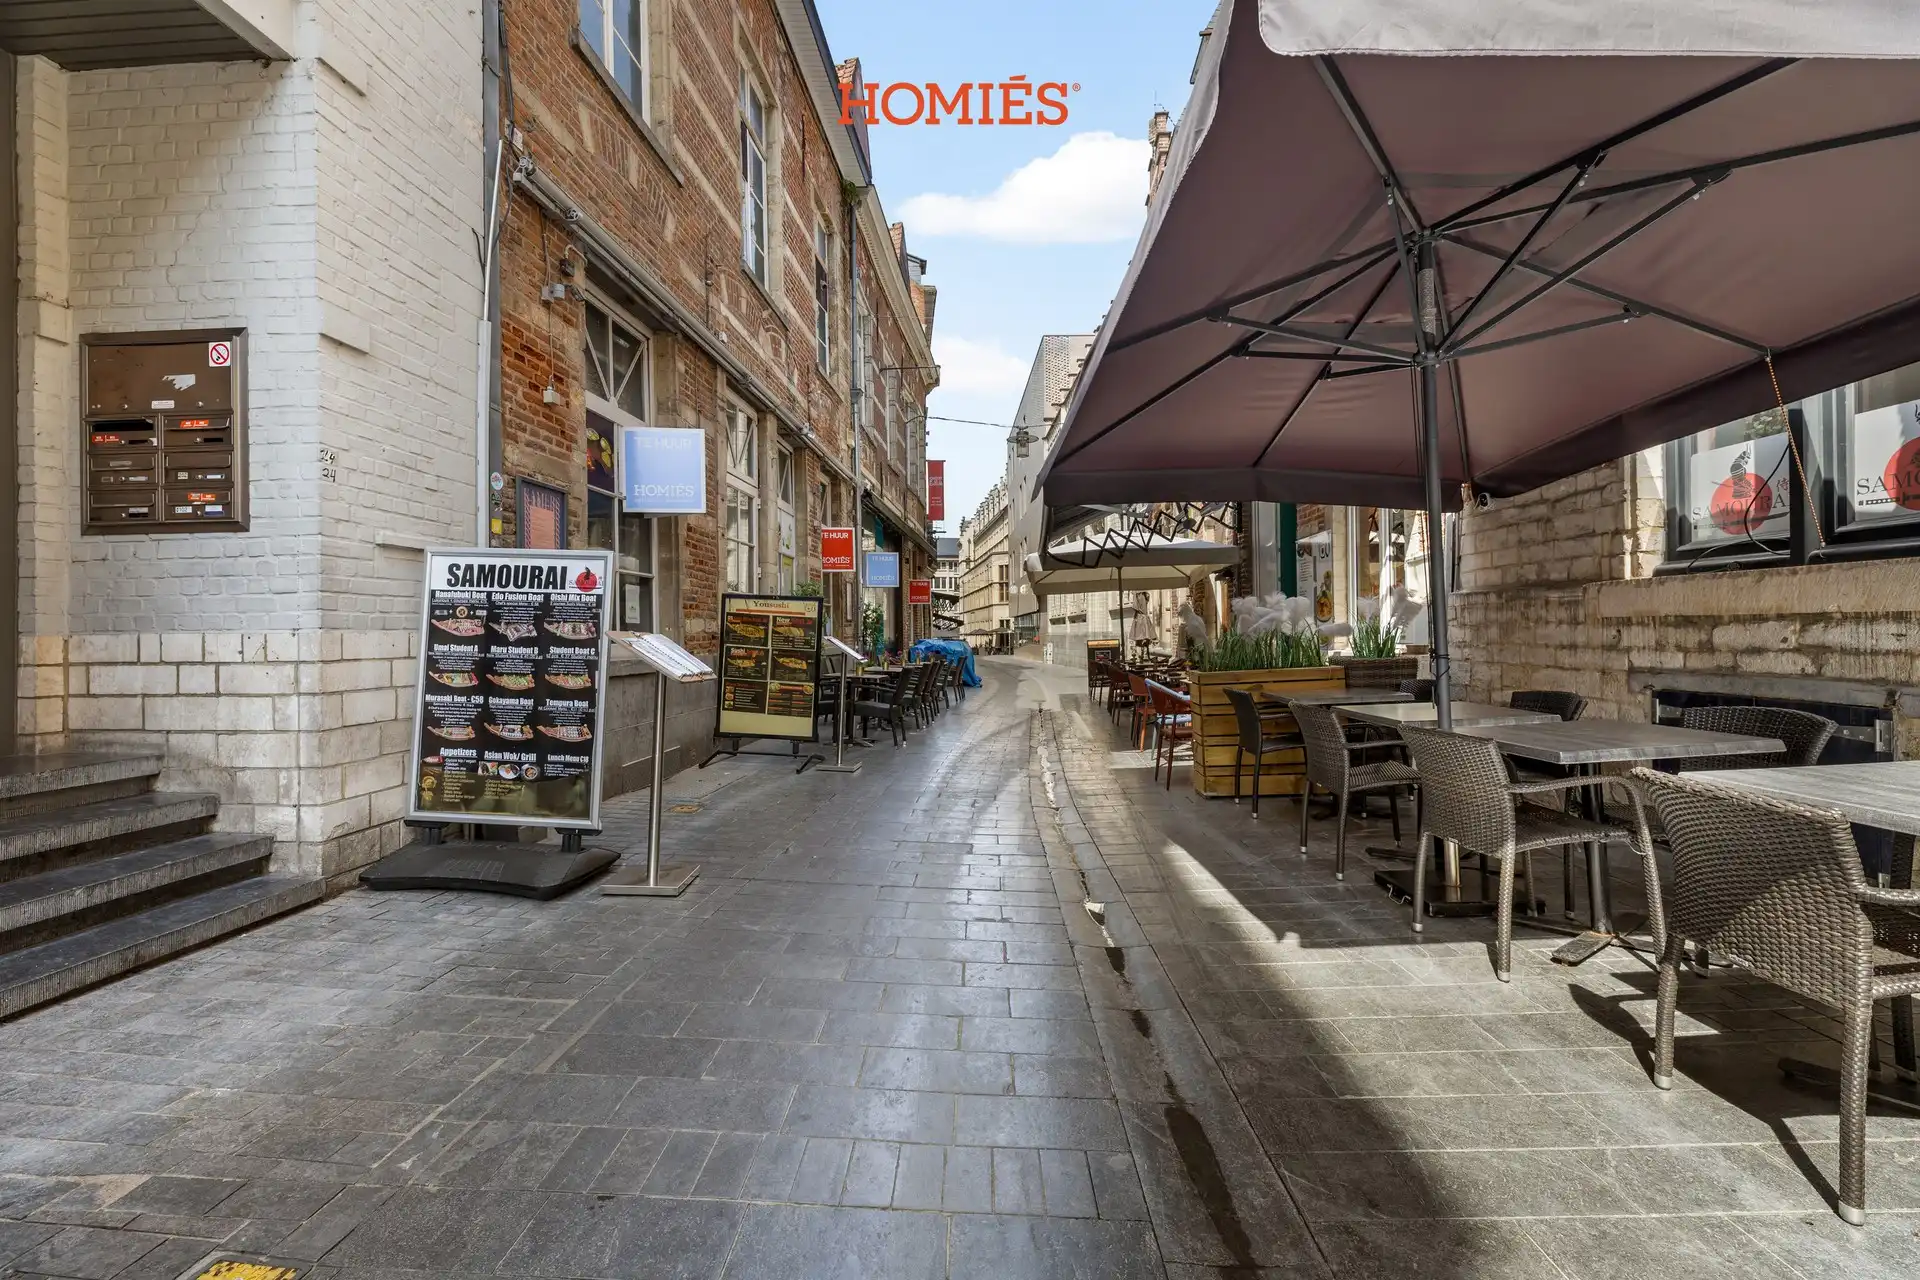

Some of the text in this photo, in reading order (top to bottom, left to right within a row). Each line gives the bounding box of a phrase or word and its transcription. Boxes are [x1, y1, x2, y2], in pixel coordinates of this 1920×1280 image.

[654, 437, 692, 449] HUUR
[322, 468, 336, 483] 24
[633, 483, 695, 496] HOMIÉS
[446, 563, 567, 590] SAMOURAI
[491, 592, 544, 602] Edo Fusion Boat
[550, 593, 597, 602] Oishi Mix Boat
[753, 600, 790, 608] Yousushi
[450, 644, 474, 652] Student
[490, 645, 507, 653] Maru
[508, 646, 531, 654] Student
[549, 646, 574, 654] Student
[575, 647, 590, 655] Boat
[425, 694, 453, 702] Murasaki
[520, 698, 534, 706] Boat
[545, 698, 589, 707] Tempura Boat
[440, 747, 477, 756] Appetizers
[484, 751, 502, 759] Asian
[521, 753, 537, 761] Grill
[565, 754, 579, 762] Menu
